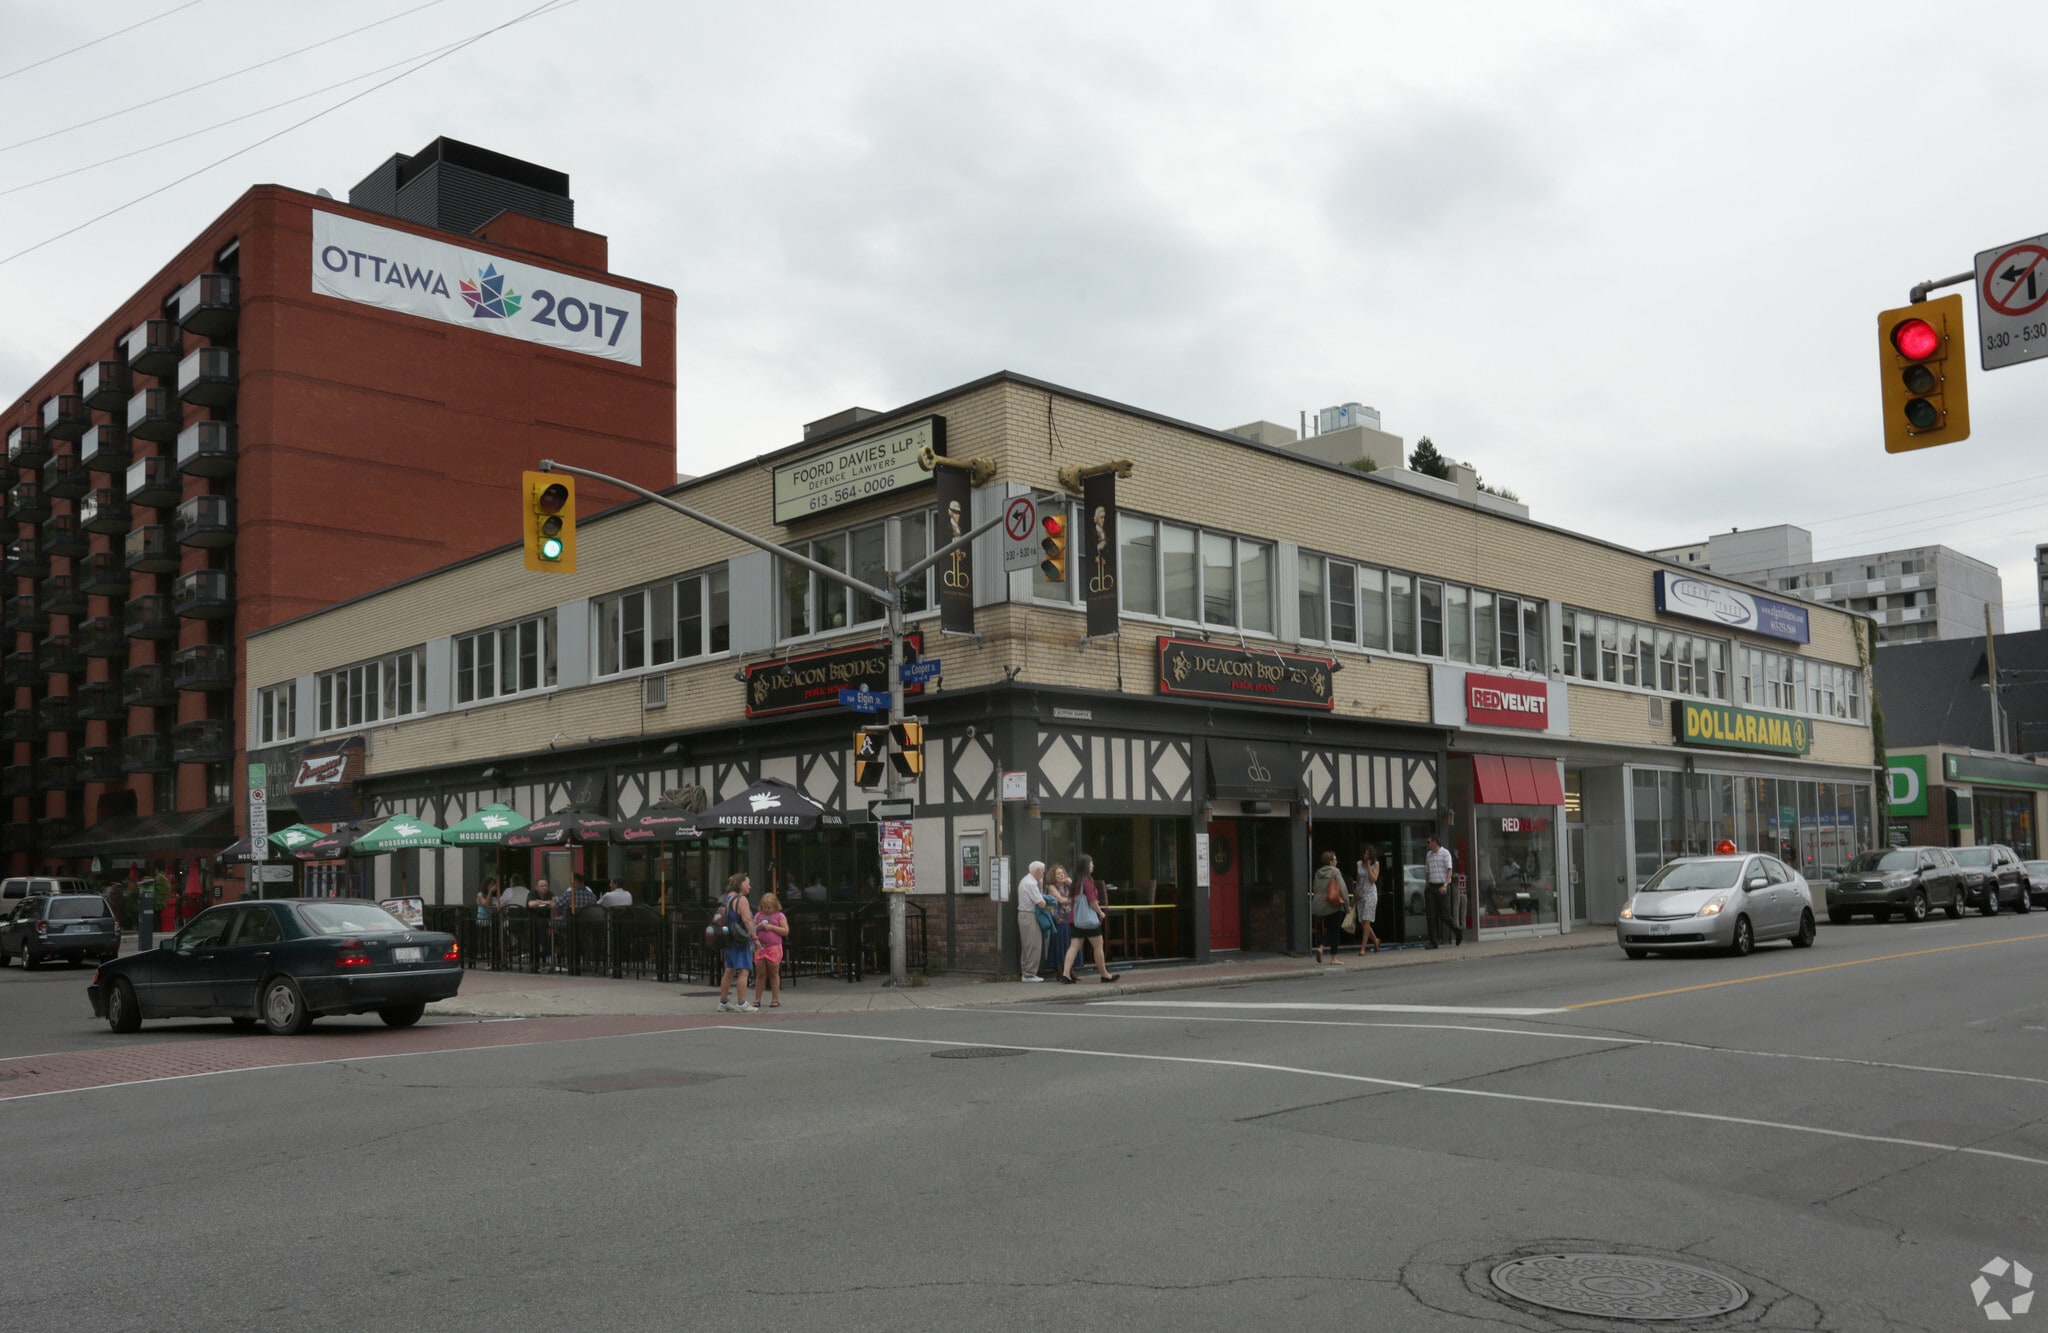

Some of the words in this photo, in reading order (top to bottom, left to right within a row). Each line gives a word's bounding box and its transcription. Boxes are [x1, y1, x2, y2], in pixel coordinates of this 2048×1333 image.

[321, 245, 451, 299] OTTAWA
[530, 289, 630, 347] 2017
[1987, 331, 2010, 350] 3:30
[2023, 322, 2047, 342] 5:30
[793, 462, 834, 486] FOORD
[839, 444, 887, 469] DAVIES
[892, 438, 913, 454] LLP
[809, 472, 846, 490] DEFENCE
[852, 458, 896, 477] LAWYERS
[771, 667, 826, 690] DEACON
[829, 656, 886, 682] BRODIES
[911, 664, 930, 676] Cooper
[1194, 656, 1253, 678] DEACON
[857, 692, 874, 706] Elgin
[1687, 706, 1793, 748] DOLLARAMA
[719, 815, 770, 825] MOOSEHEAD
[773, 816, 800, 825] LAGER
[378, 838, 417, 848] MOOSEHEAD
[459, 832, 502, 840] MOOSEHEAD
